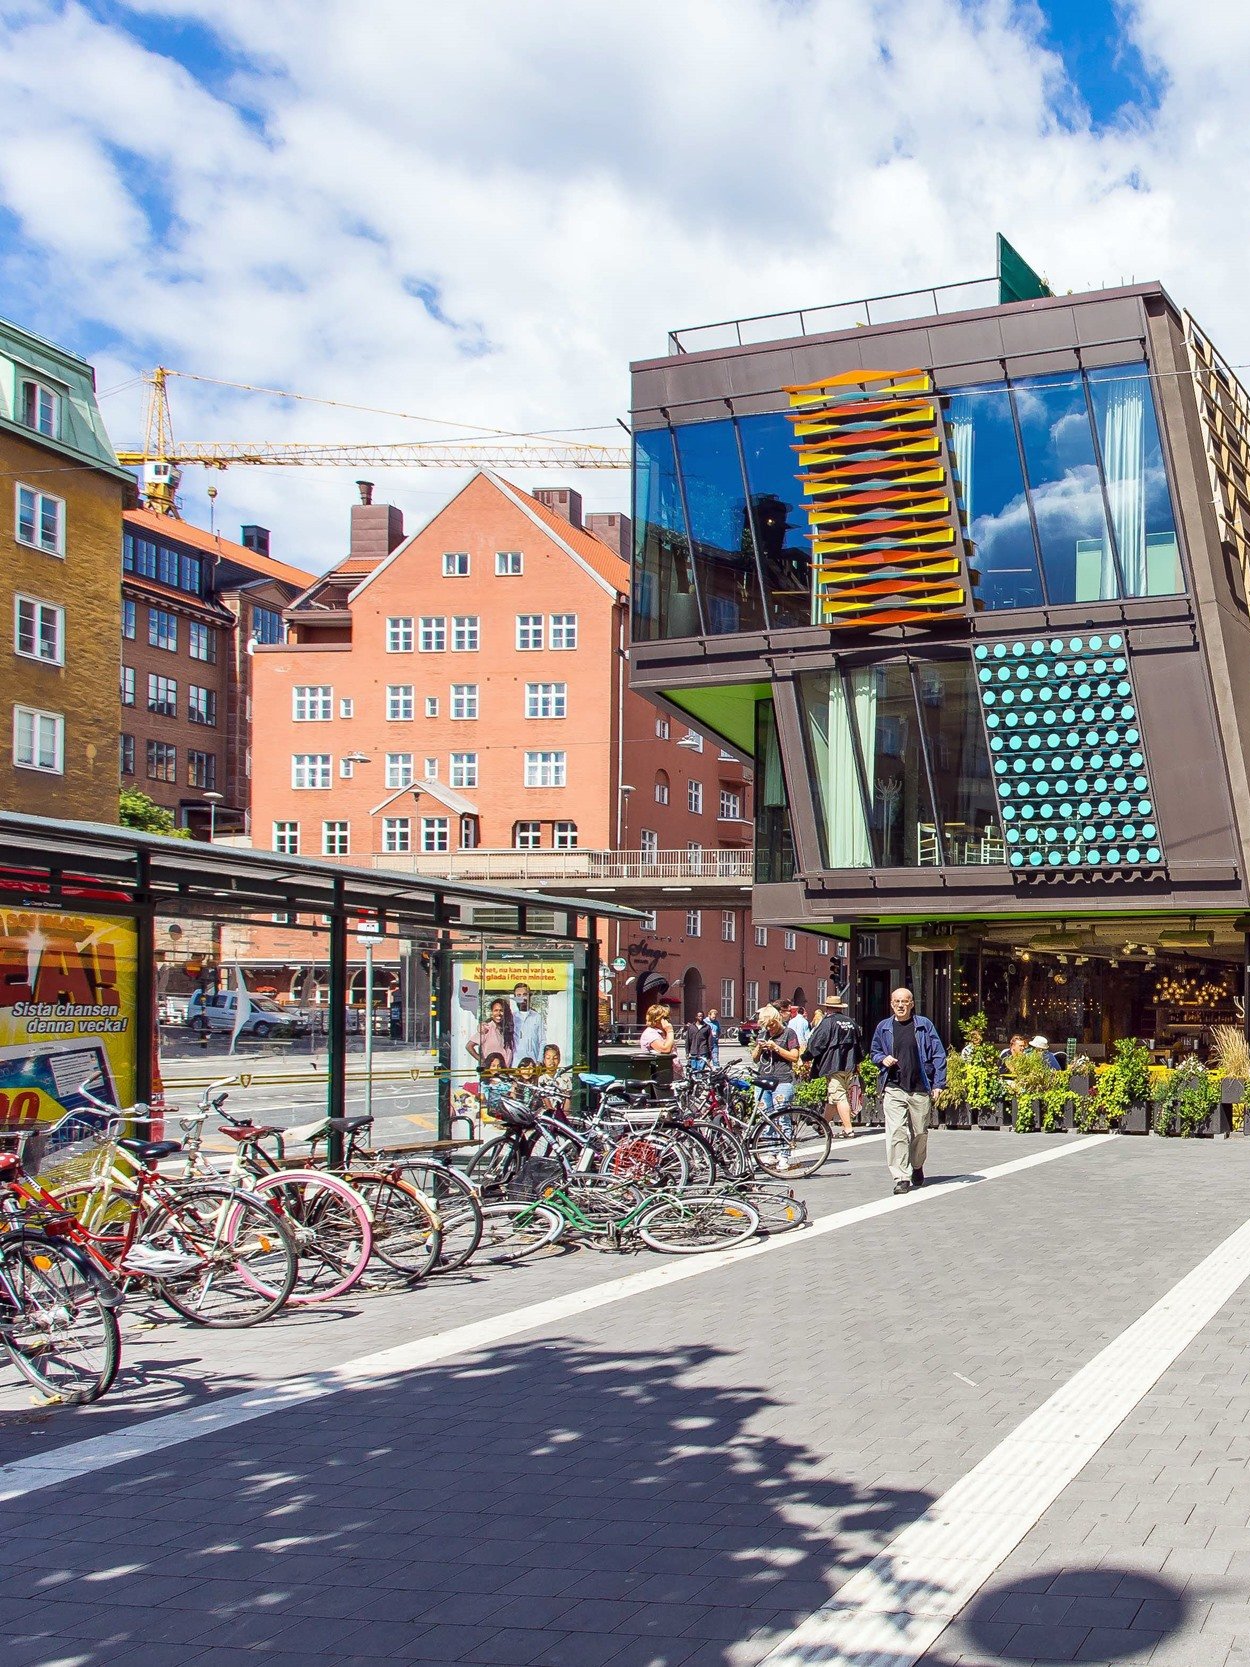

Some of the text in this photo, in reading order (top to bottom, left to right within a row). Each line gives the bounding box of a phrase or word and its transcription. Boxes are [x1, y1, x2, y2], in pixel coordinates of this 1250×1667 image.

[508, 966, 522, 974] kan
[486, 973, 507, 981] glada
[12, 1001, 119, 1016] Sista chansen
[27, 1018, 129, 1034] denna vecka!
